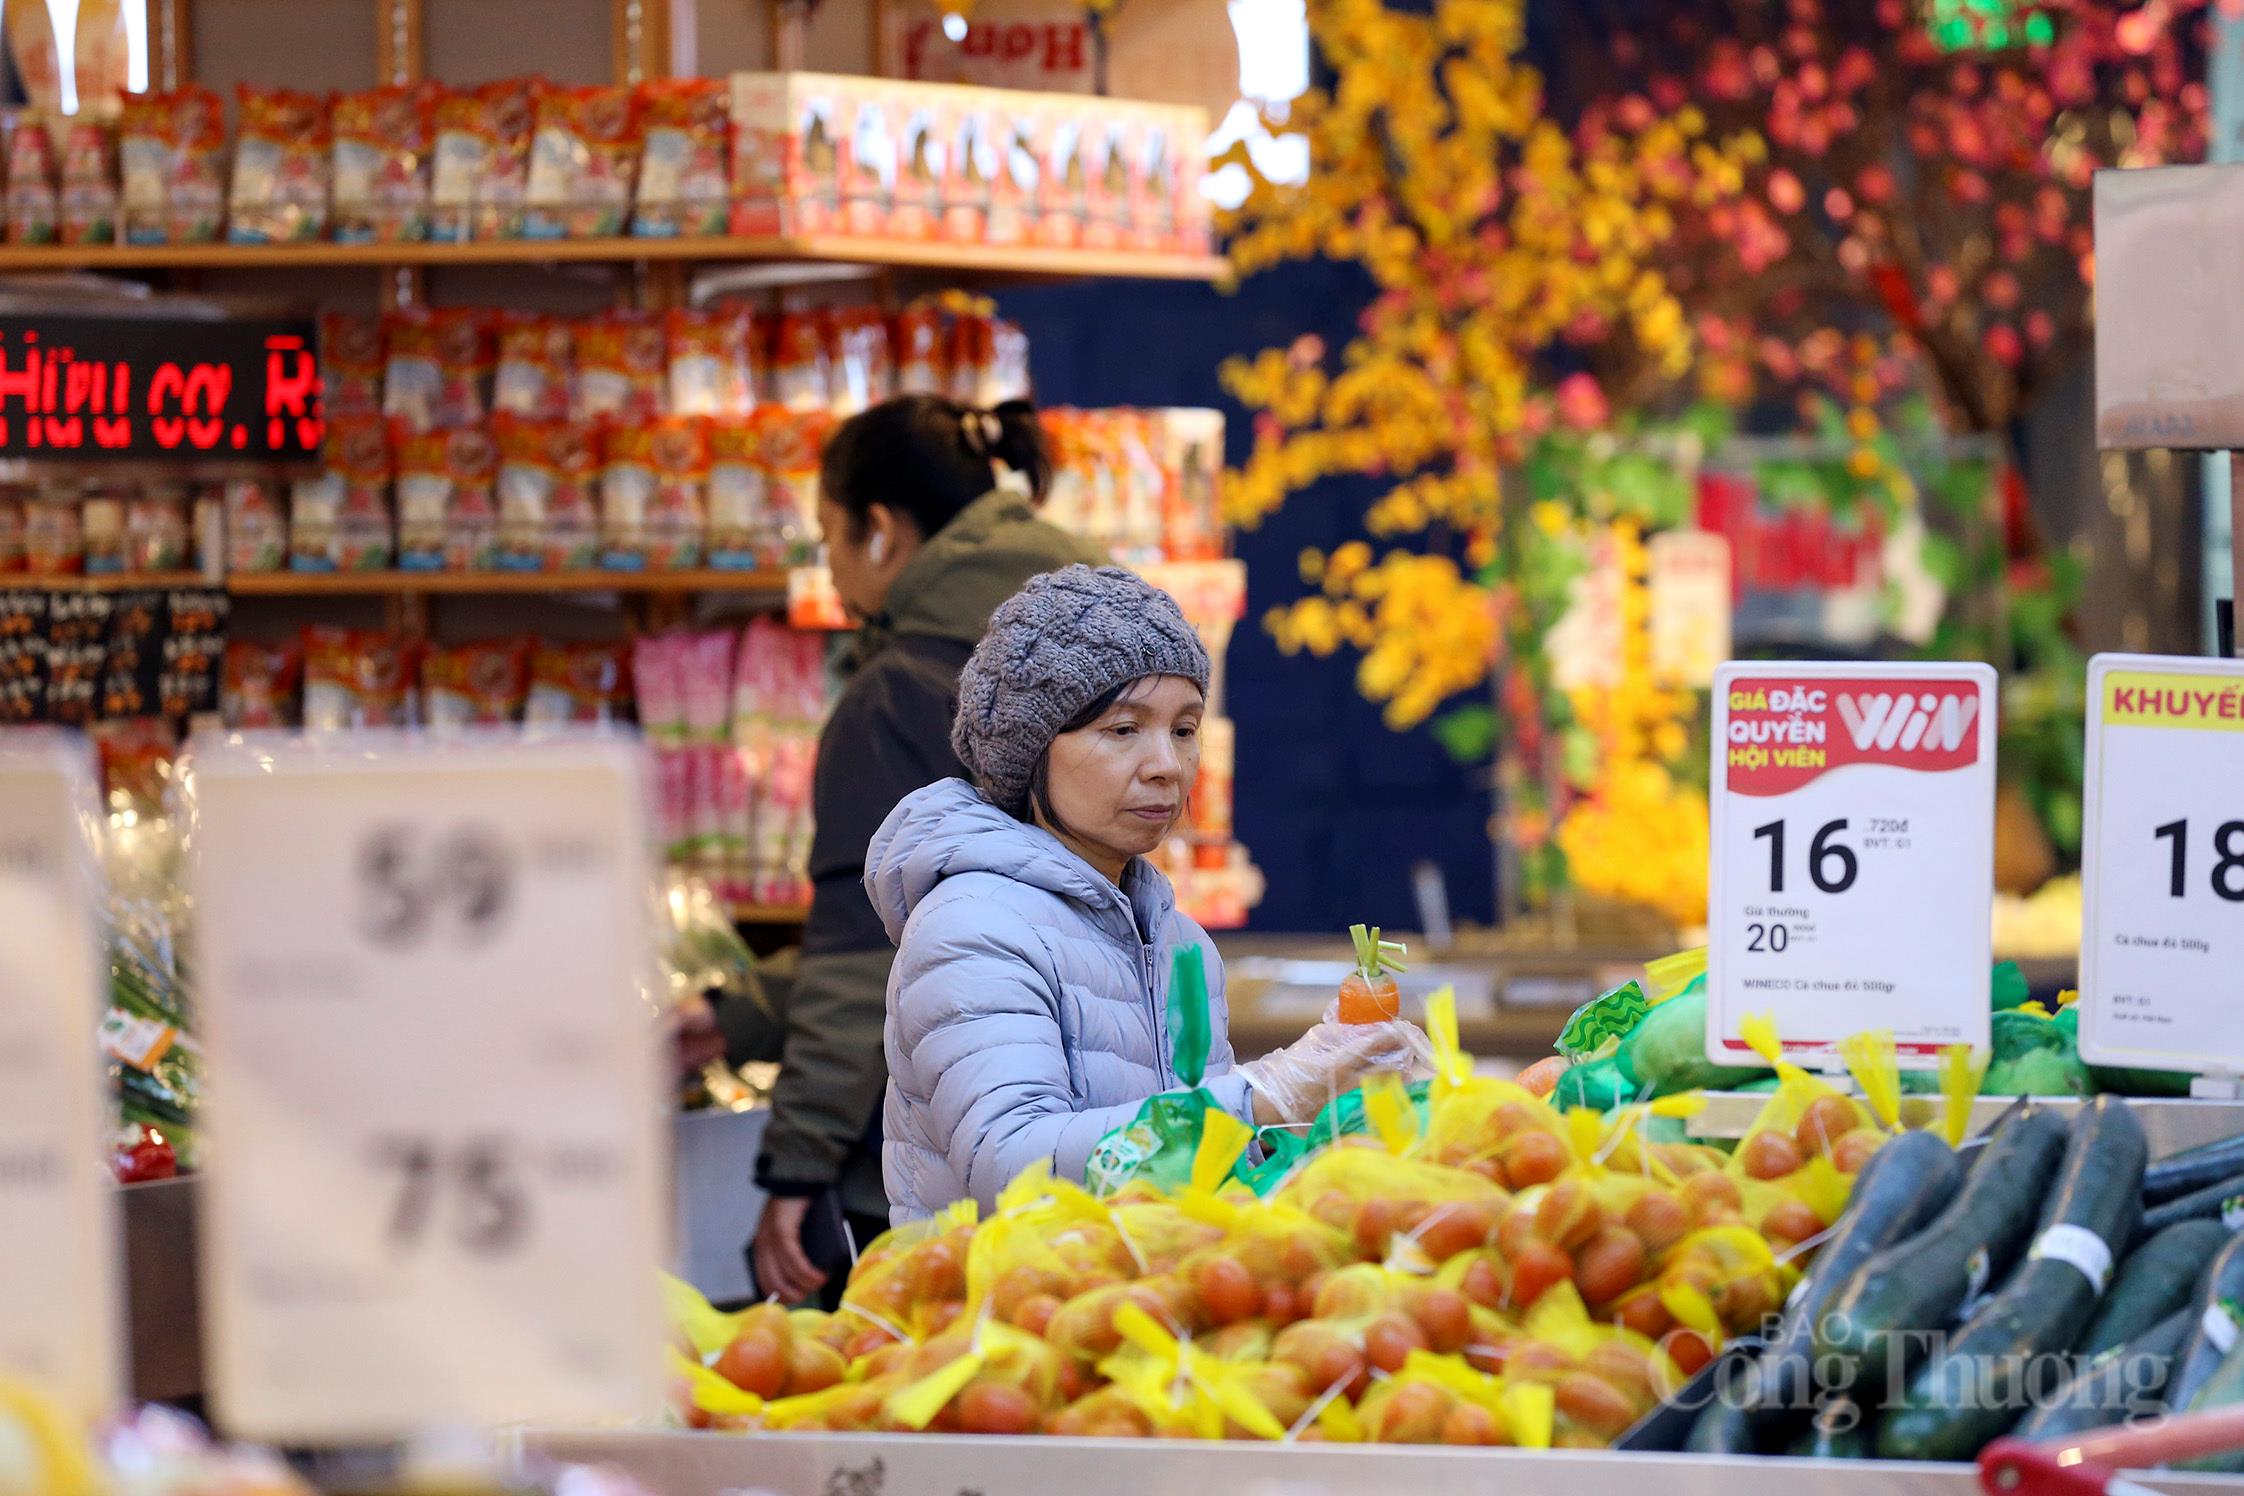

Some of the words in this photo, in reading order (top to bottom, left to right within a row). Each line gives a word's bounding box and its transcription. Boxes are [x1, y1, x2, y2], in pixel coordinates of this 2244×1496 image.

[1728, 687, 1769, 712] GIÁ
[2114, 683, 2244, 719] KHUYẾ
[1728, 713, 1827, 744] QUYỀN
[1728, 745, 1769, 773] HỘI
[1772, 744, 1827, 768] VIÊN
[1754, 818, 1858, 894] 16
[2154, 818, 2244, 902] 18
[1747, 923, 1788, 952] 20
